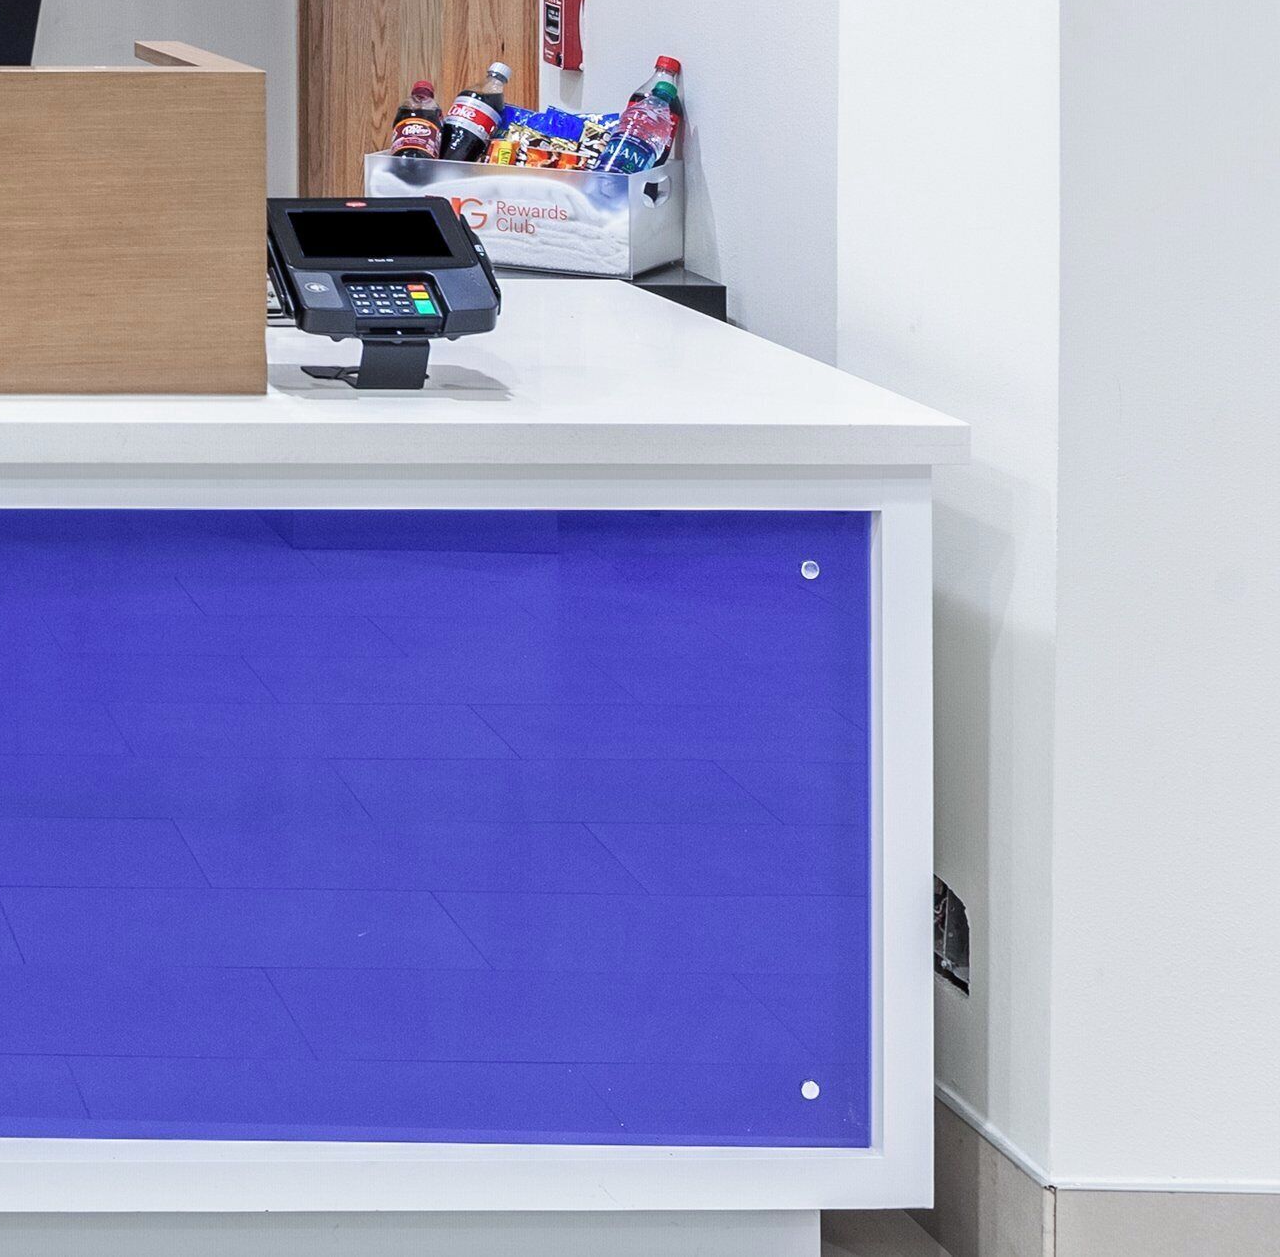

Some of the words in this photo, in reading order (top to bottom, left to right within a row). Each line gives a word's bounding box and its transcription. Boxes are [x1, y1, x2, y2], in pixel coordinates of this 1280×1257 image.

[447, 104, 477, 120] Coke
[607, 144, 645, 168] AANI
[496, 200, 568, 221] Rewards
[496, 217, 536, 235] Club
